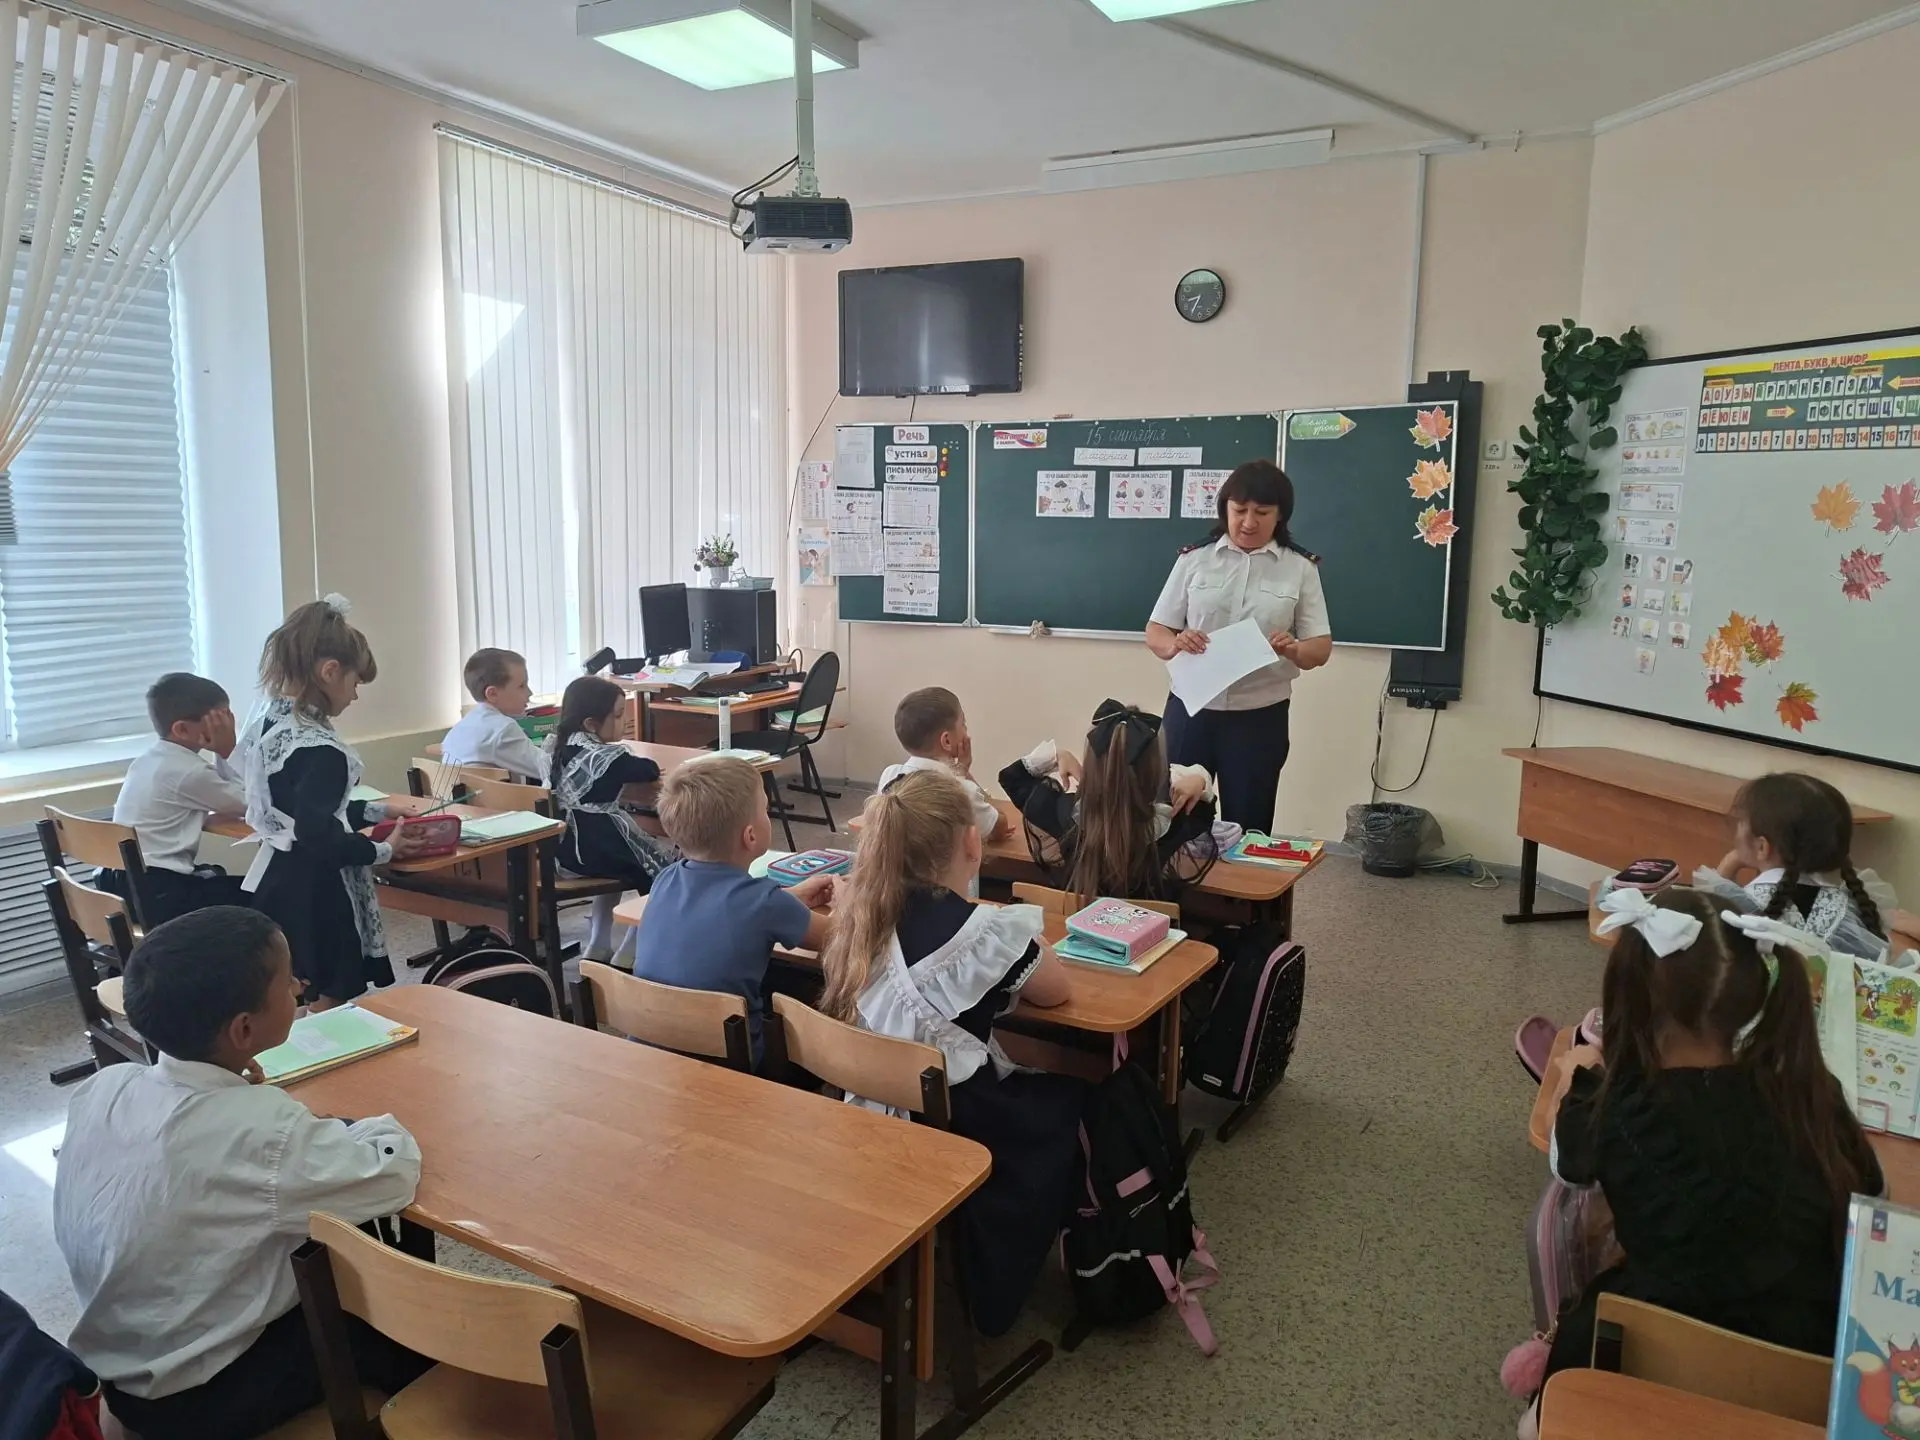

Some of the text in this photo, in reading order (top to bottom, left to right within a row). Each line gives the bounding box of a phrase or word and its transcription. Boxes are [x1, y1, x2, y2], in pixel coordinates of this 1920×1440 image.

[1772, 353, 1869, 371] ЛЕНТА БУКВ И ЦИФР
[898, 429, 925, 440] Речь
[1086, 427, 1105, 445] 15
[1699, 438, 1704, 447] 0
[1709, 438, 1713, 447] 1
[1719, 437, 1725, 446] 2
[1730, 437, 1736, 446] 3
[1740, 437, 1746, 446] 4
[1751, 436, 1757, 445] 5
[1762, 436, 1769, 445] 6
[1774, 435, 1780, 445] 7
[1785, 435, 1792, 445] 8
[1798, 435, 1804, 444] 9
[1808, 434, 1817, 444] 10
[1821, 433, 1831, 444] 11
[1834, 433, 1843, 443] 12
[1846, 432, 1856, 443] 13
[1859, 431, 1869, 442] 14
[1871, 431, 1882, 441] 15
[1885, 430, 1896, 441] 16
[1899, 429, 1910, 441] 17
[894, 450, 928, 460] устная
[886, 466, 937, 474] письменная
